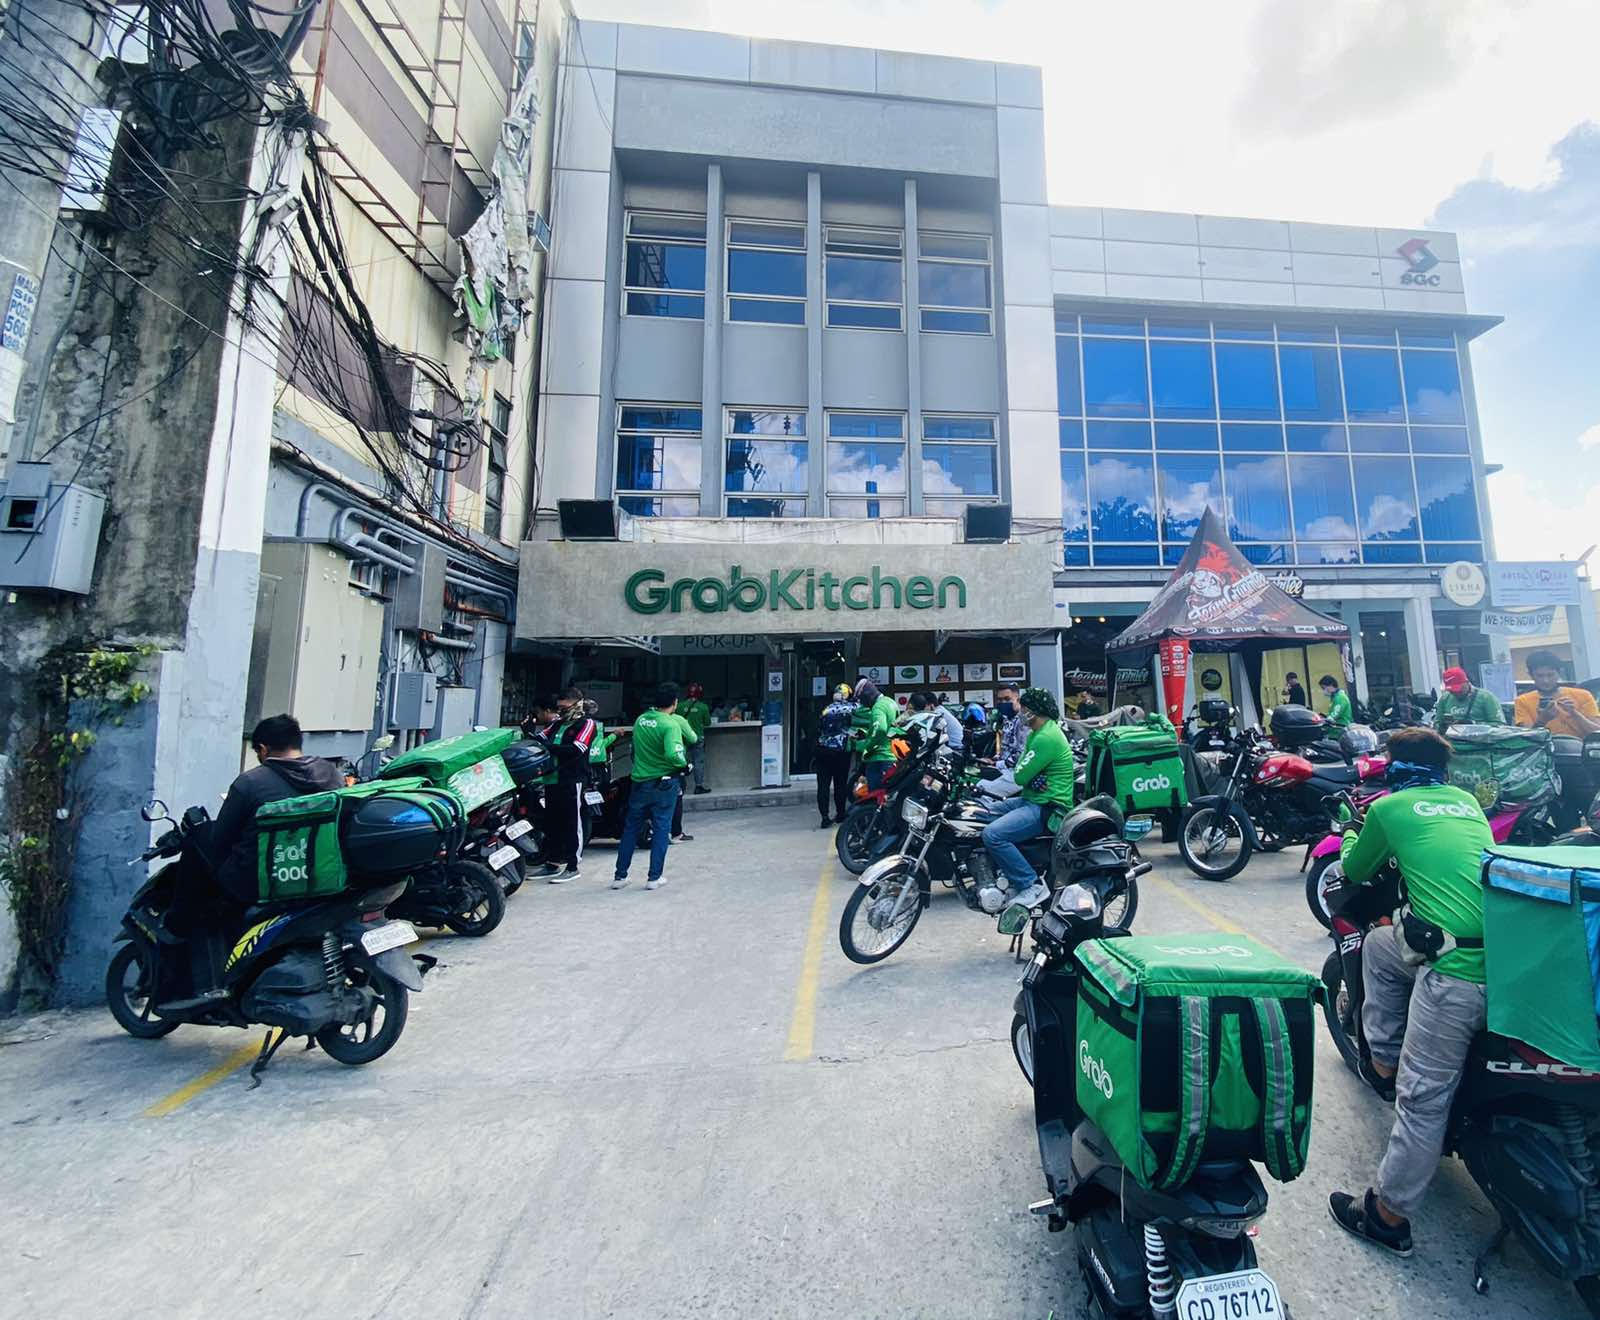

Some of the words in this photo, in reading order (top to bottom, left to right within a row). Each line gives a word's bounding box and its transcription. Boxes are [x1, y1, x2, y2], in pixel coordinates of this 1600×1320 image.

[682, 634, 755, 650] PICK-UP
[1131, 773, 1171, 793] Grab
[1412, 800, 1480, 818] Grab
[1079, 1039, 1114, 1100] Grab
[1203, 1280, 1247, 1293] REGISTERED
[1187, 1297, 1216, 1320] CD
[1218, 1287, 1275, 1320] 76712
